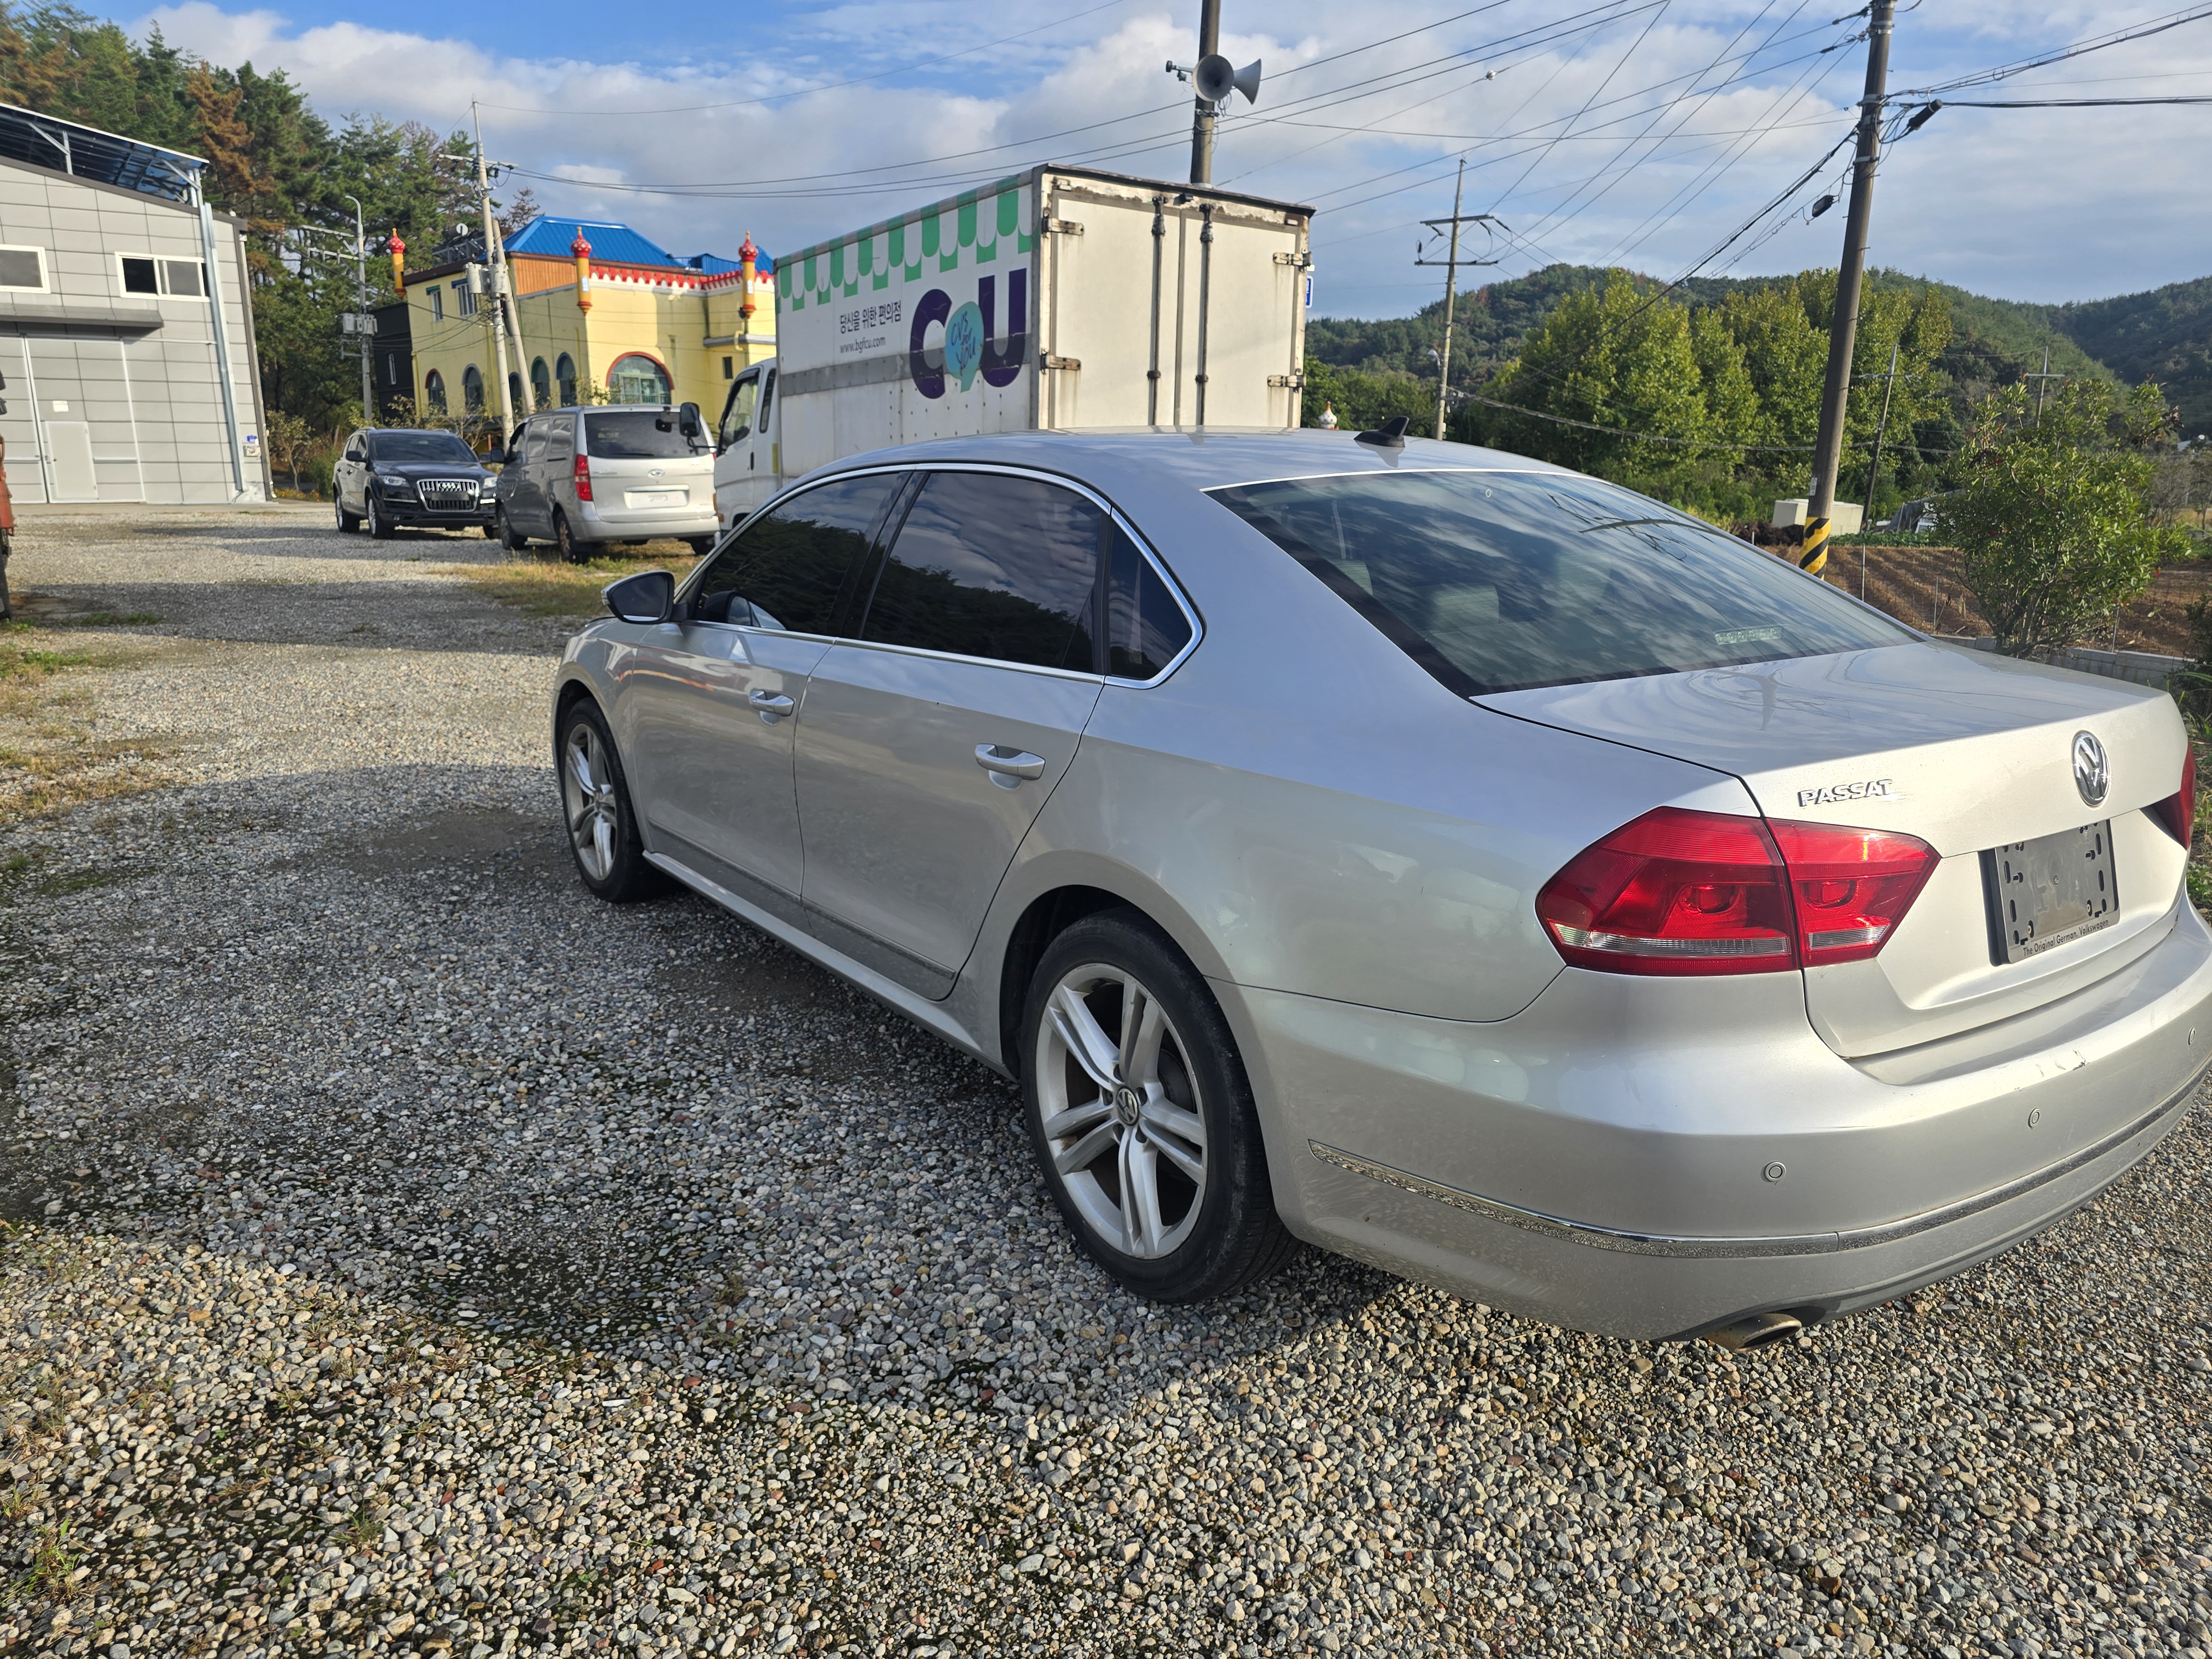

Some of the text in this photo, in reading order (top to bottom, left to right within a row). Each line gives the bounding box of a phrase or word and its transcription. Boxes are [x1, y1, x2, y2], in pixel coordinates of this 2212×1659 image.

[840, 300, 901, 334] 당신을 위한 편의점
[840, 336, 886, 354] www.bgfcu.com
[1797, 779, 1893, 807] PASSAT
[2023, 919, 2109, 957] The Original German. Volkswagen
